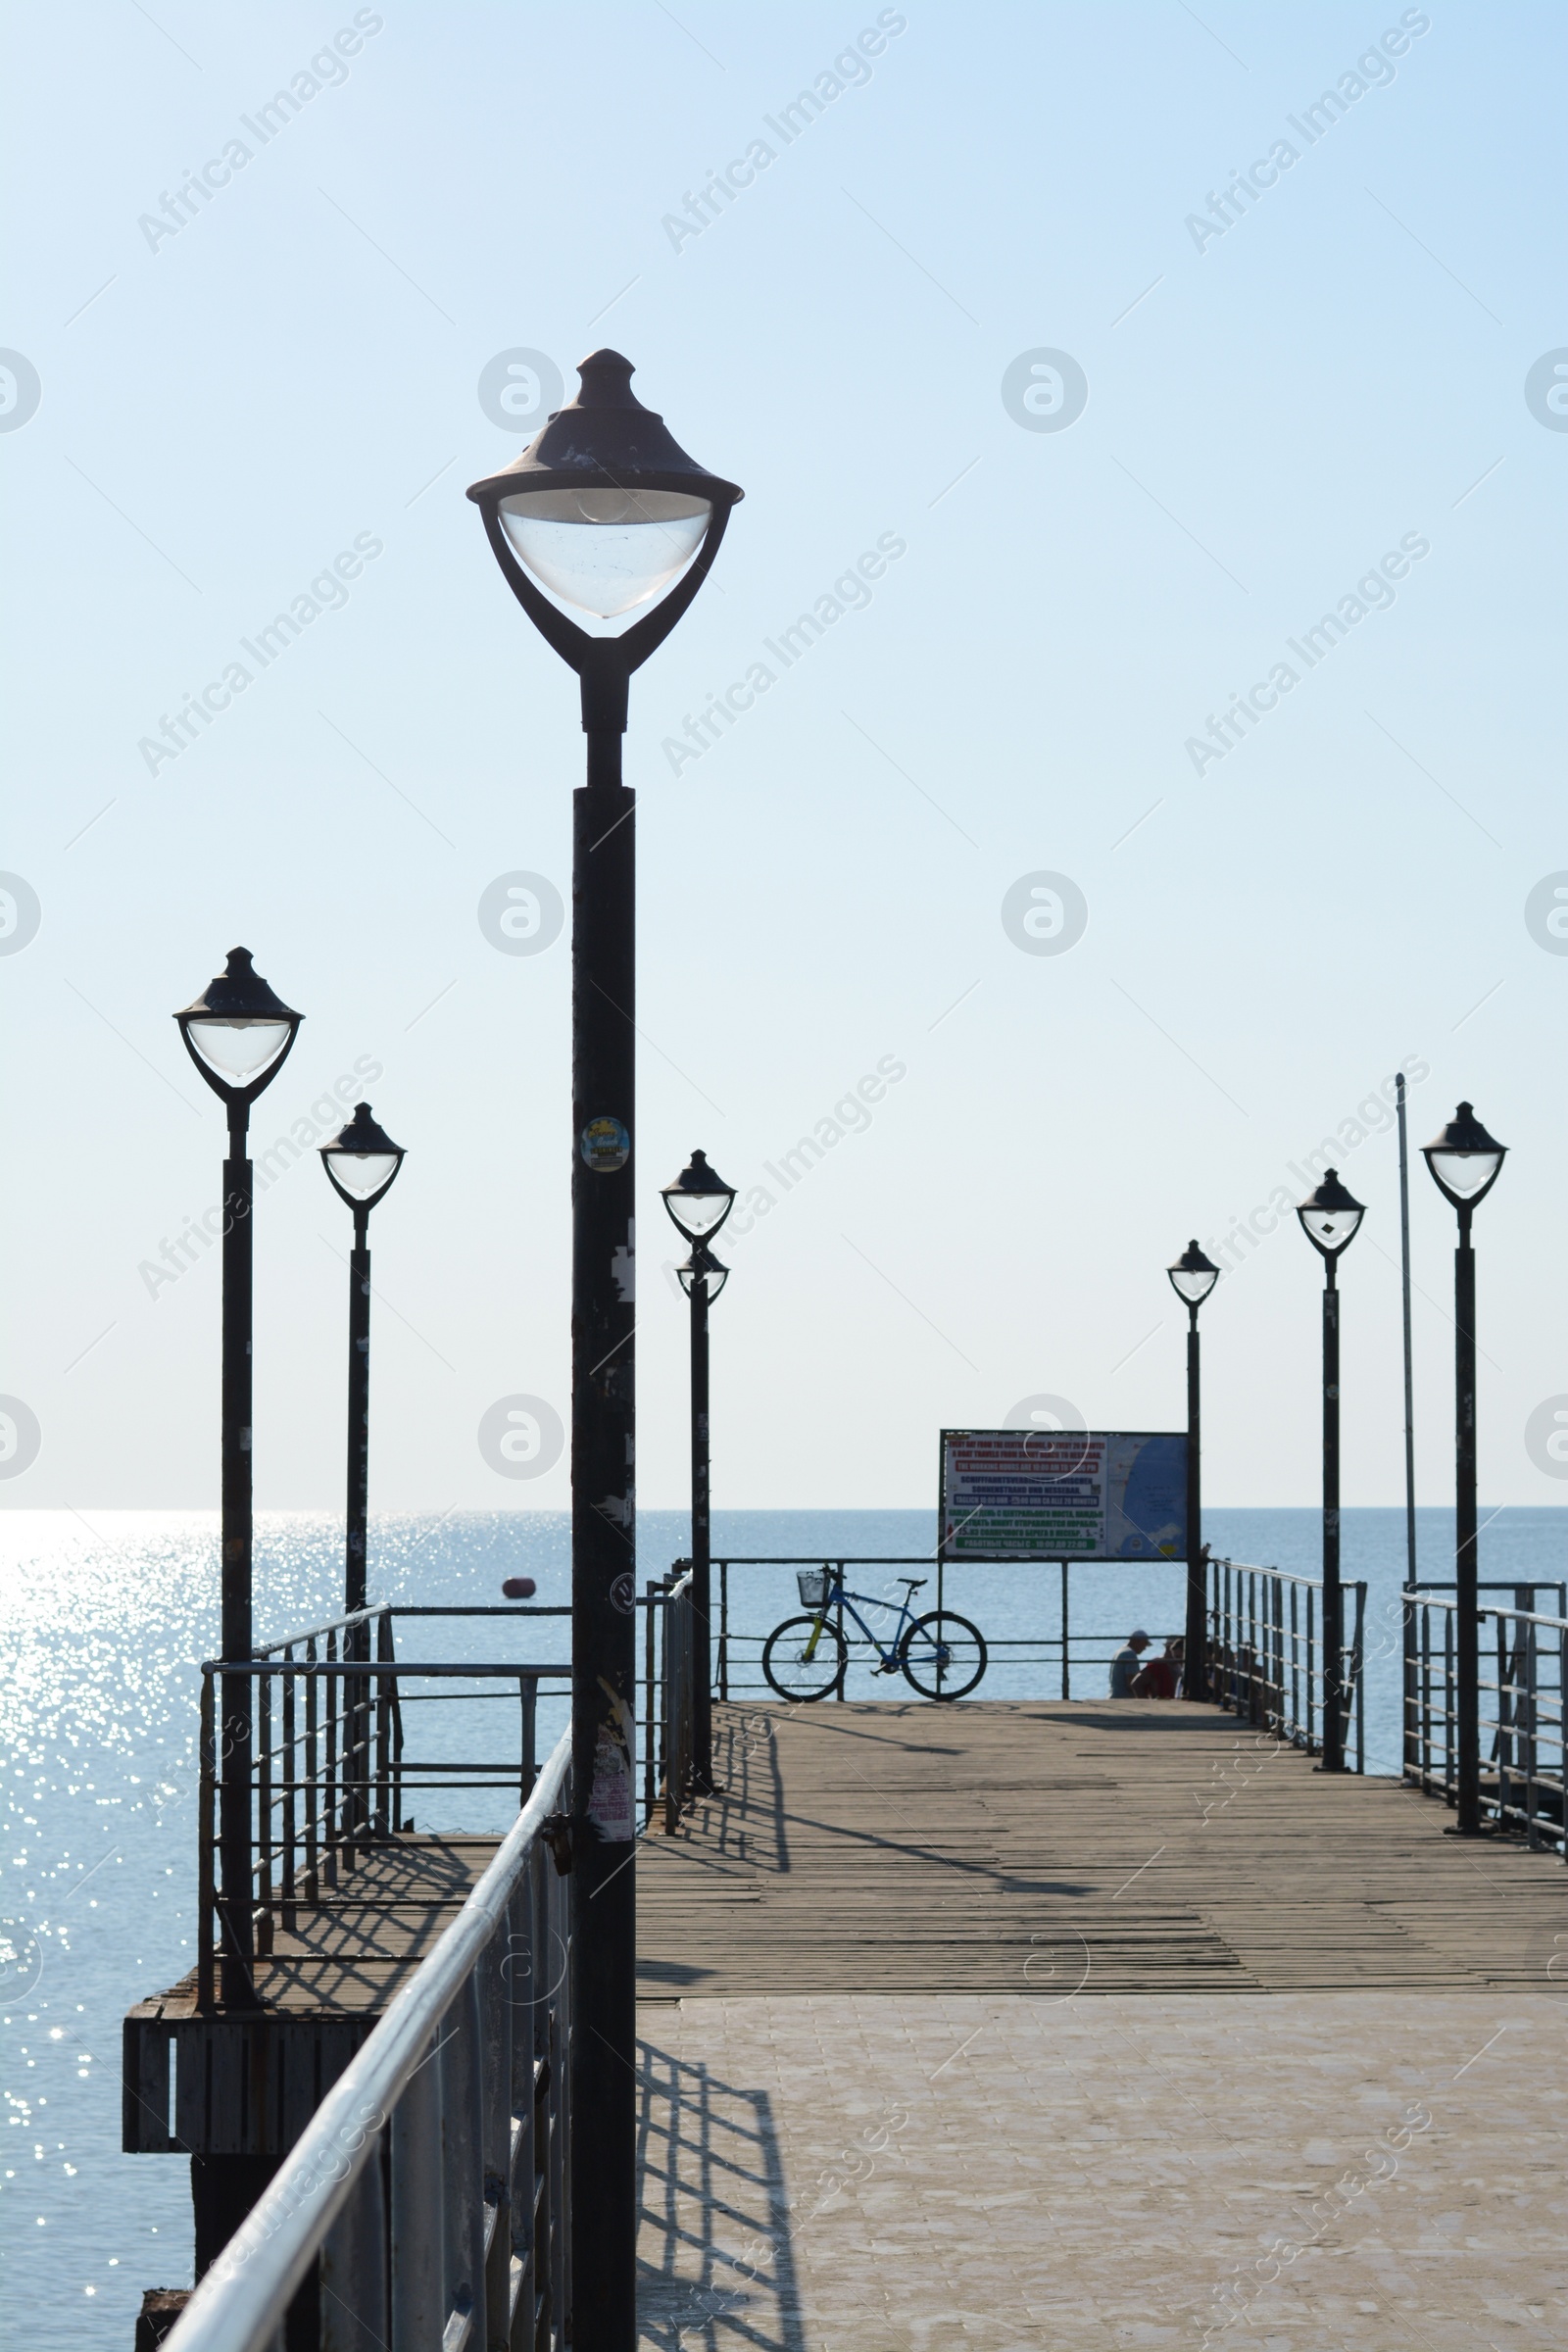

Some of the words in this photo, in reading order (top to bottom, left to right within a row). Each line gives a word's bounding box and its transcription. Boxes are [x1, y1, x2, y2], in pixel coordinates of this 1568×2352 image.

[597, 1136, 618, 1146] Beach
[1003, 1540, 1025, 1548] ЧАСЫ
[1055, 1541, 1066, 1549] ДО
